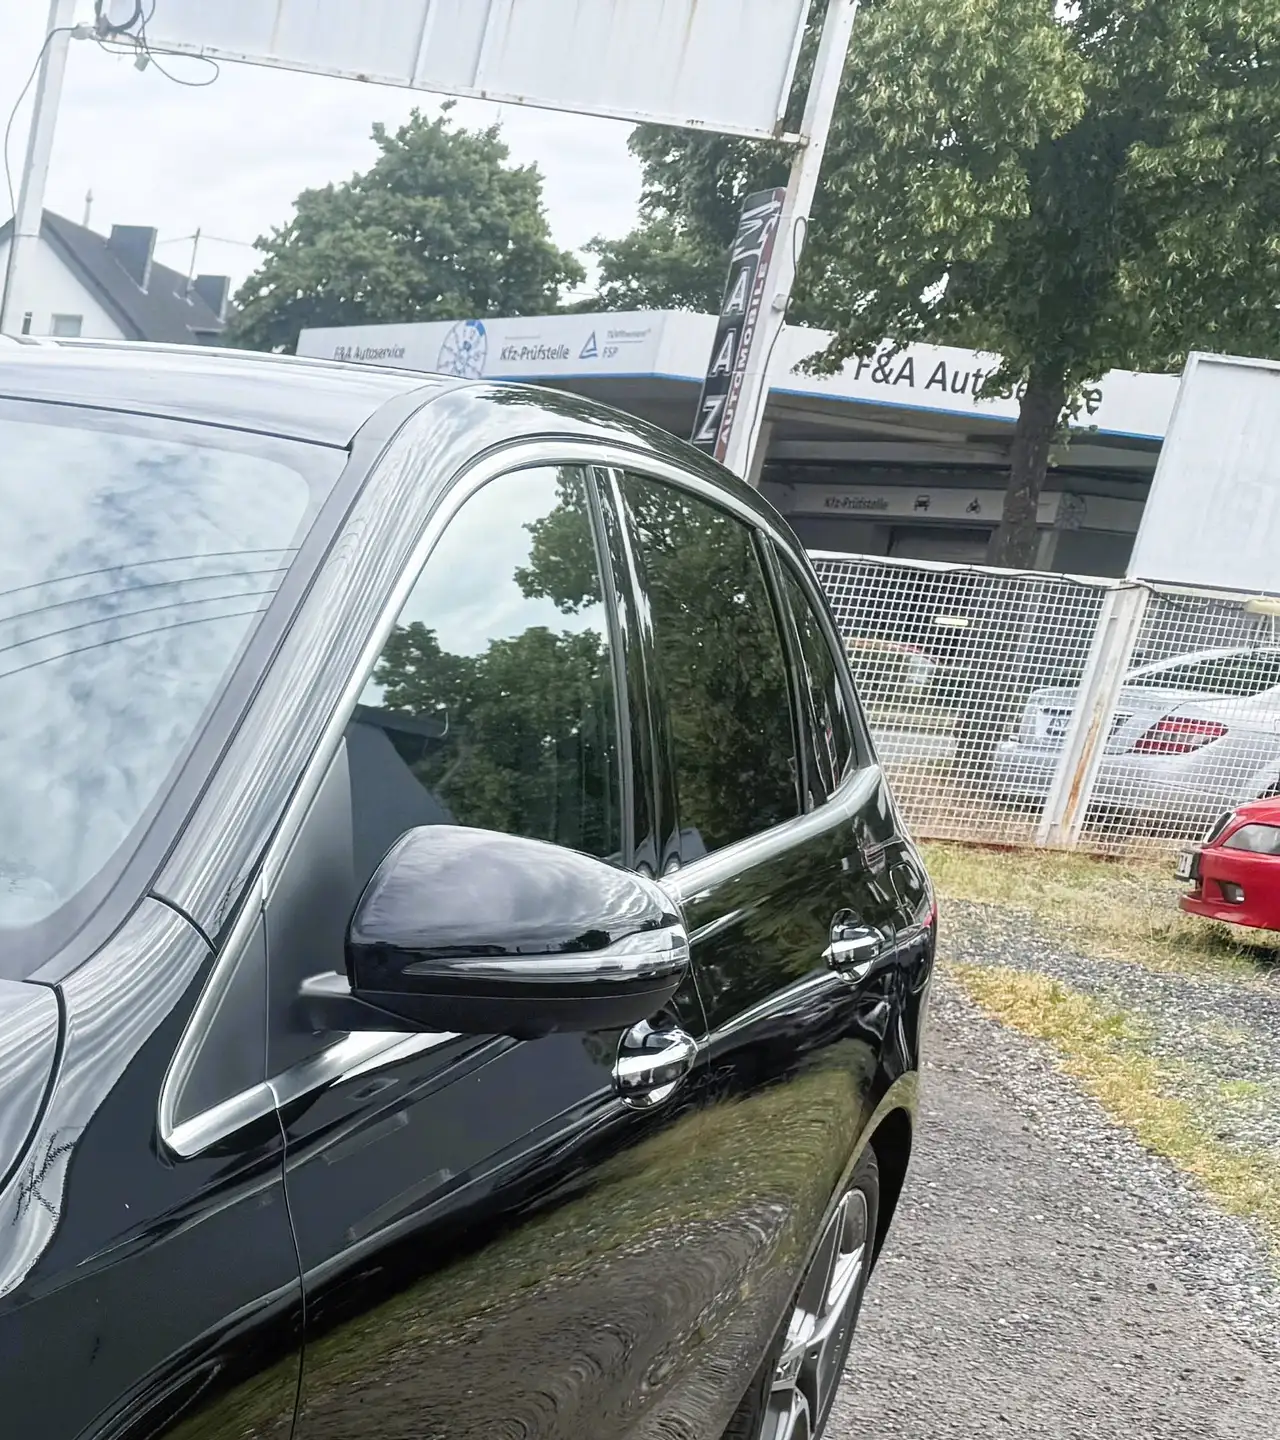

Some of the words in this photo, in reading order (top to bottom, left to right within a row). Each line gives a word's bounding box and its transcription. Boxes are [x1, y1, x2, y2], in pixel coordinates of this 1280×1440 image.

[353, 344, 405, 360] Autoservice
[500, 344, 570, 361] Kfz-Prüfstelle
[602, 346, 619, 358] FSP
[721, 262, 768, 444] AUTOMOBILE
